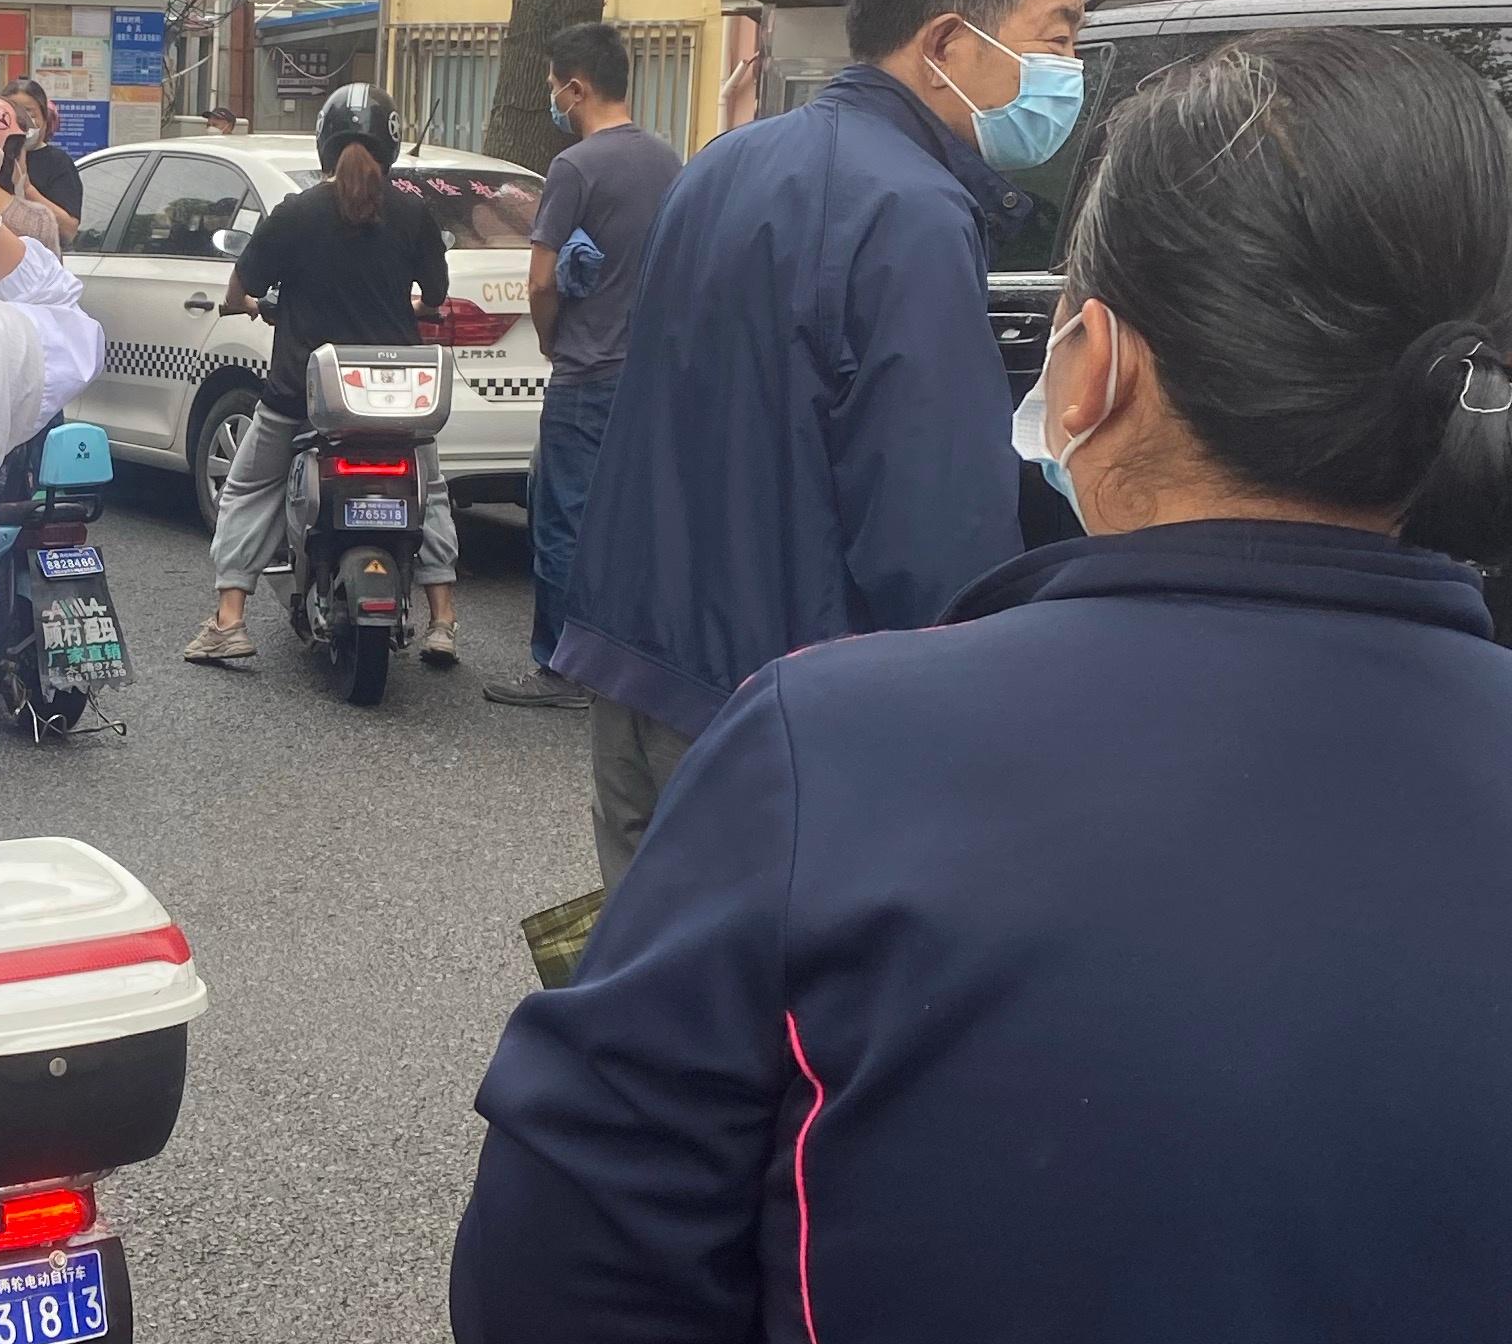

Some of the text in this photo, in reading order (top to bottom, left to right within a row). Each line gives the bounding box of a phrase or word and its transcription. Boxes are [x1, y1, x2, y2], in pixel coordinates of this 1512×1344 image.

[482, 280, 530, 303] C1C2
[351, 509, 402, 520] 7765518
[48, 642, 122, 667] 厂家直销
